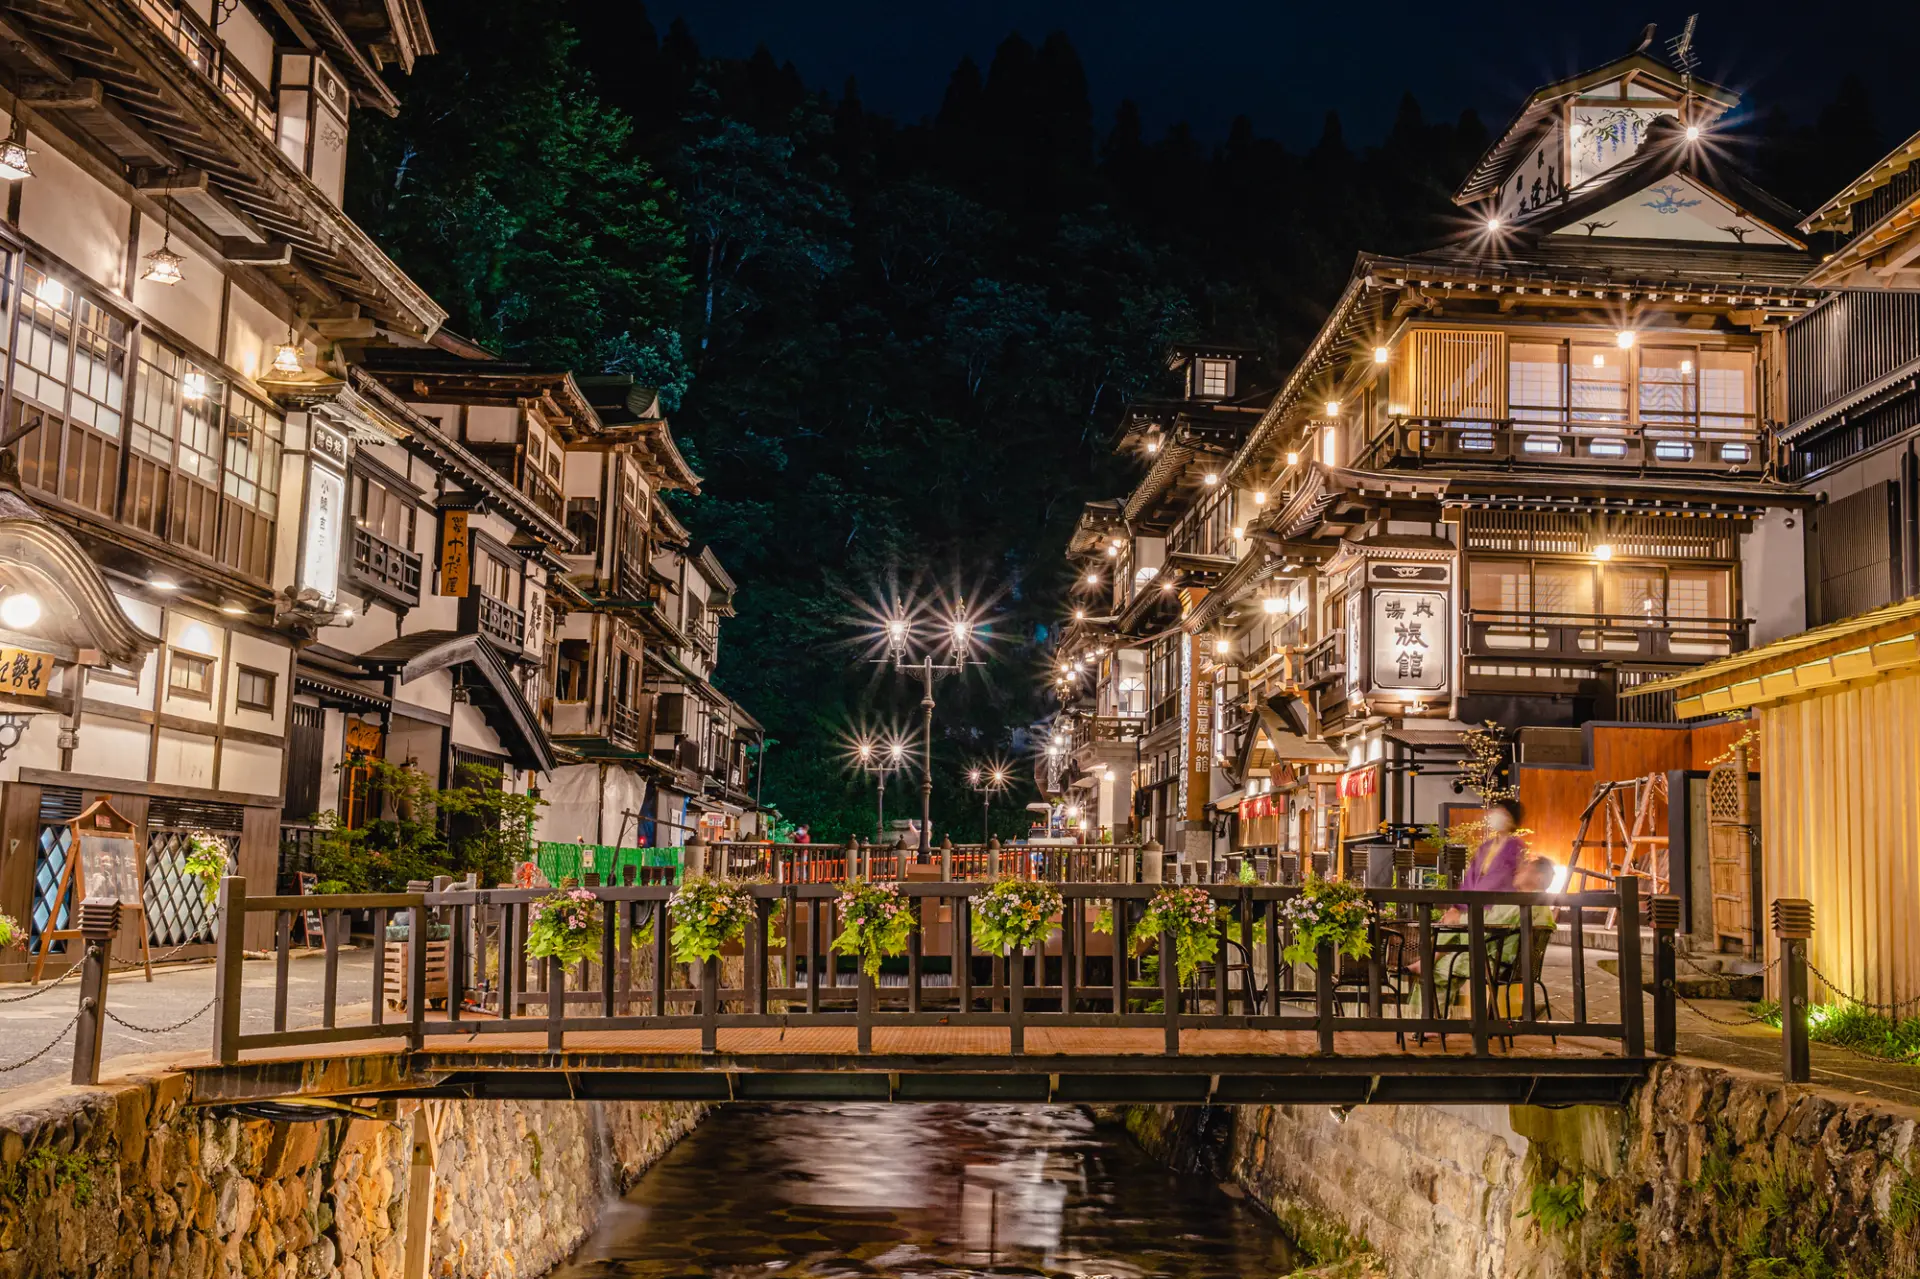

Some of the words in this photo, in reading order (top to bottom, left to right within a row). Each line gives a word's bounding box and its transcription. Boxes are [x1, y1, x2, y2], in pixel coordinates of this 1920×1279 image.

[1394, 621, 1429, 679] 旅館
[1196, 681, 1210, 773] 能登屋旅館
